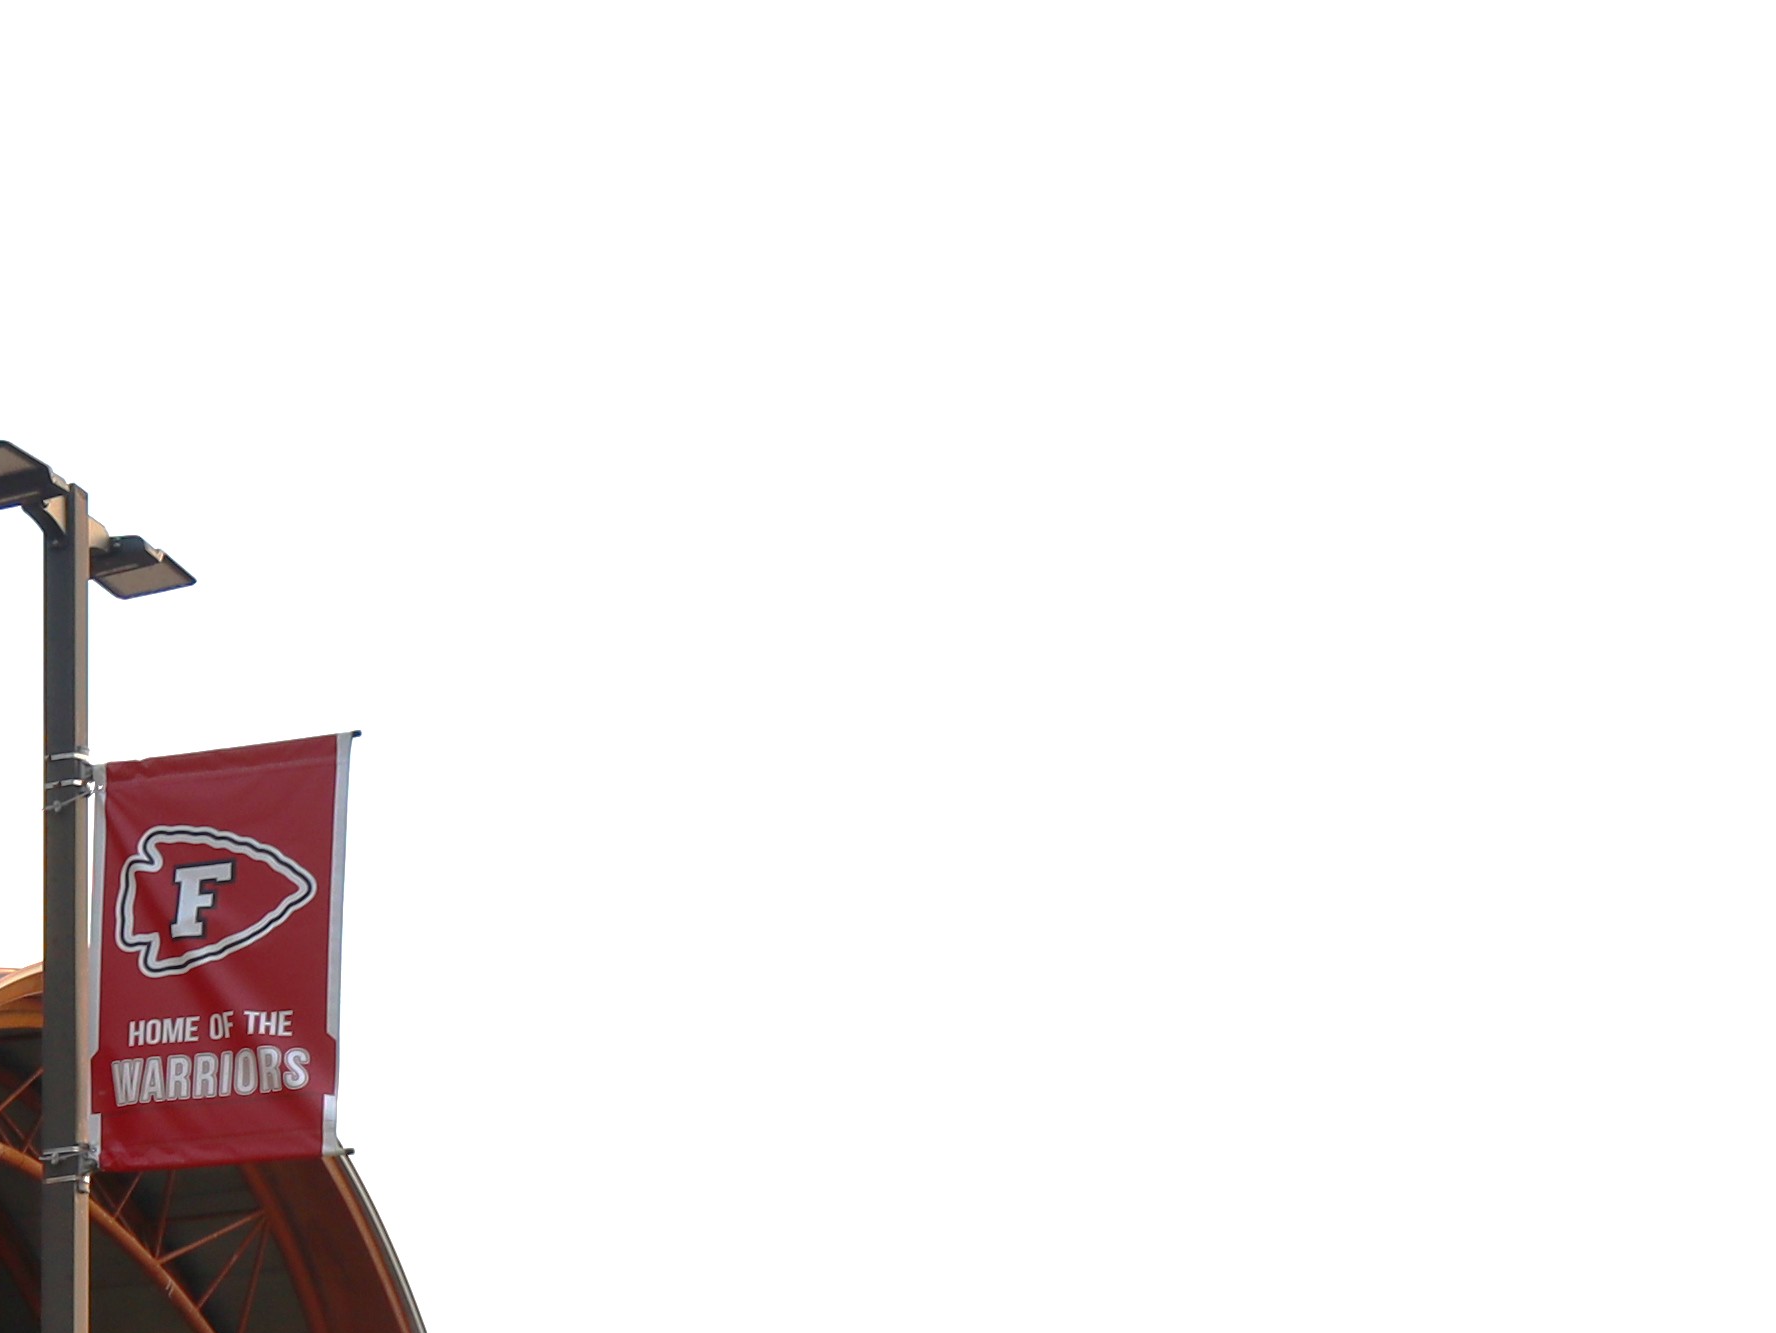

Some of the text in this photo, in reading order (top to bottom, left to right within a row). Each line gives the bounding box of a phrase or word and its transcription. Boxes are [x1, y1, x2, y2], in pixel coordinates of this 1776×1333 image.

[170, 860, 234, 939] F
[127, 1009, 294, 1047] HOME OF THE
[111, 1045, 311, 1107] WARRIORS
